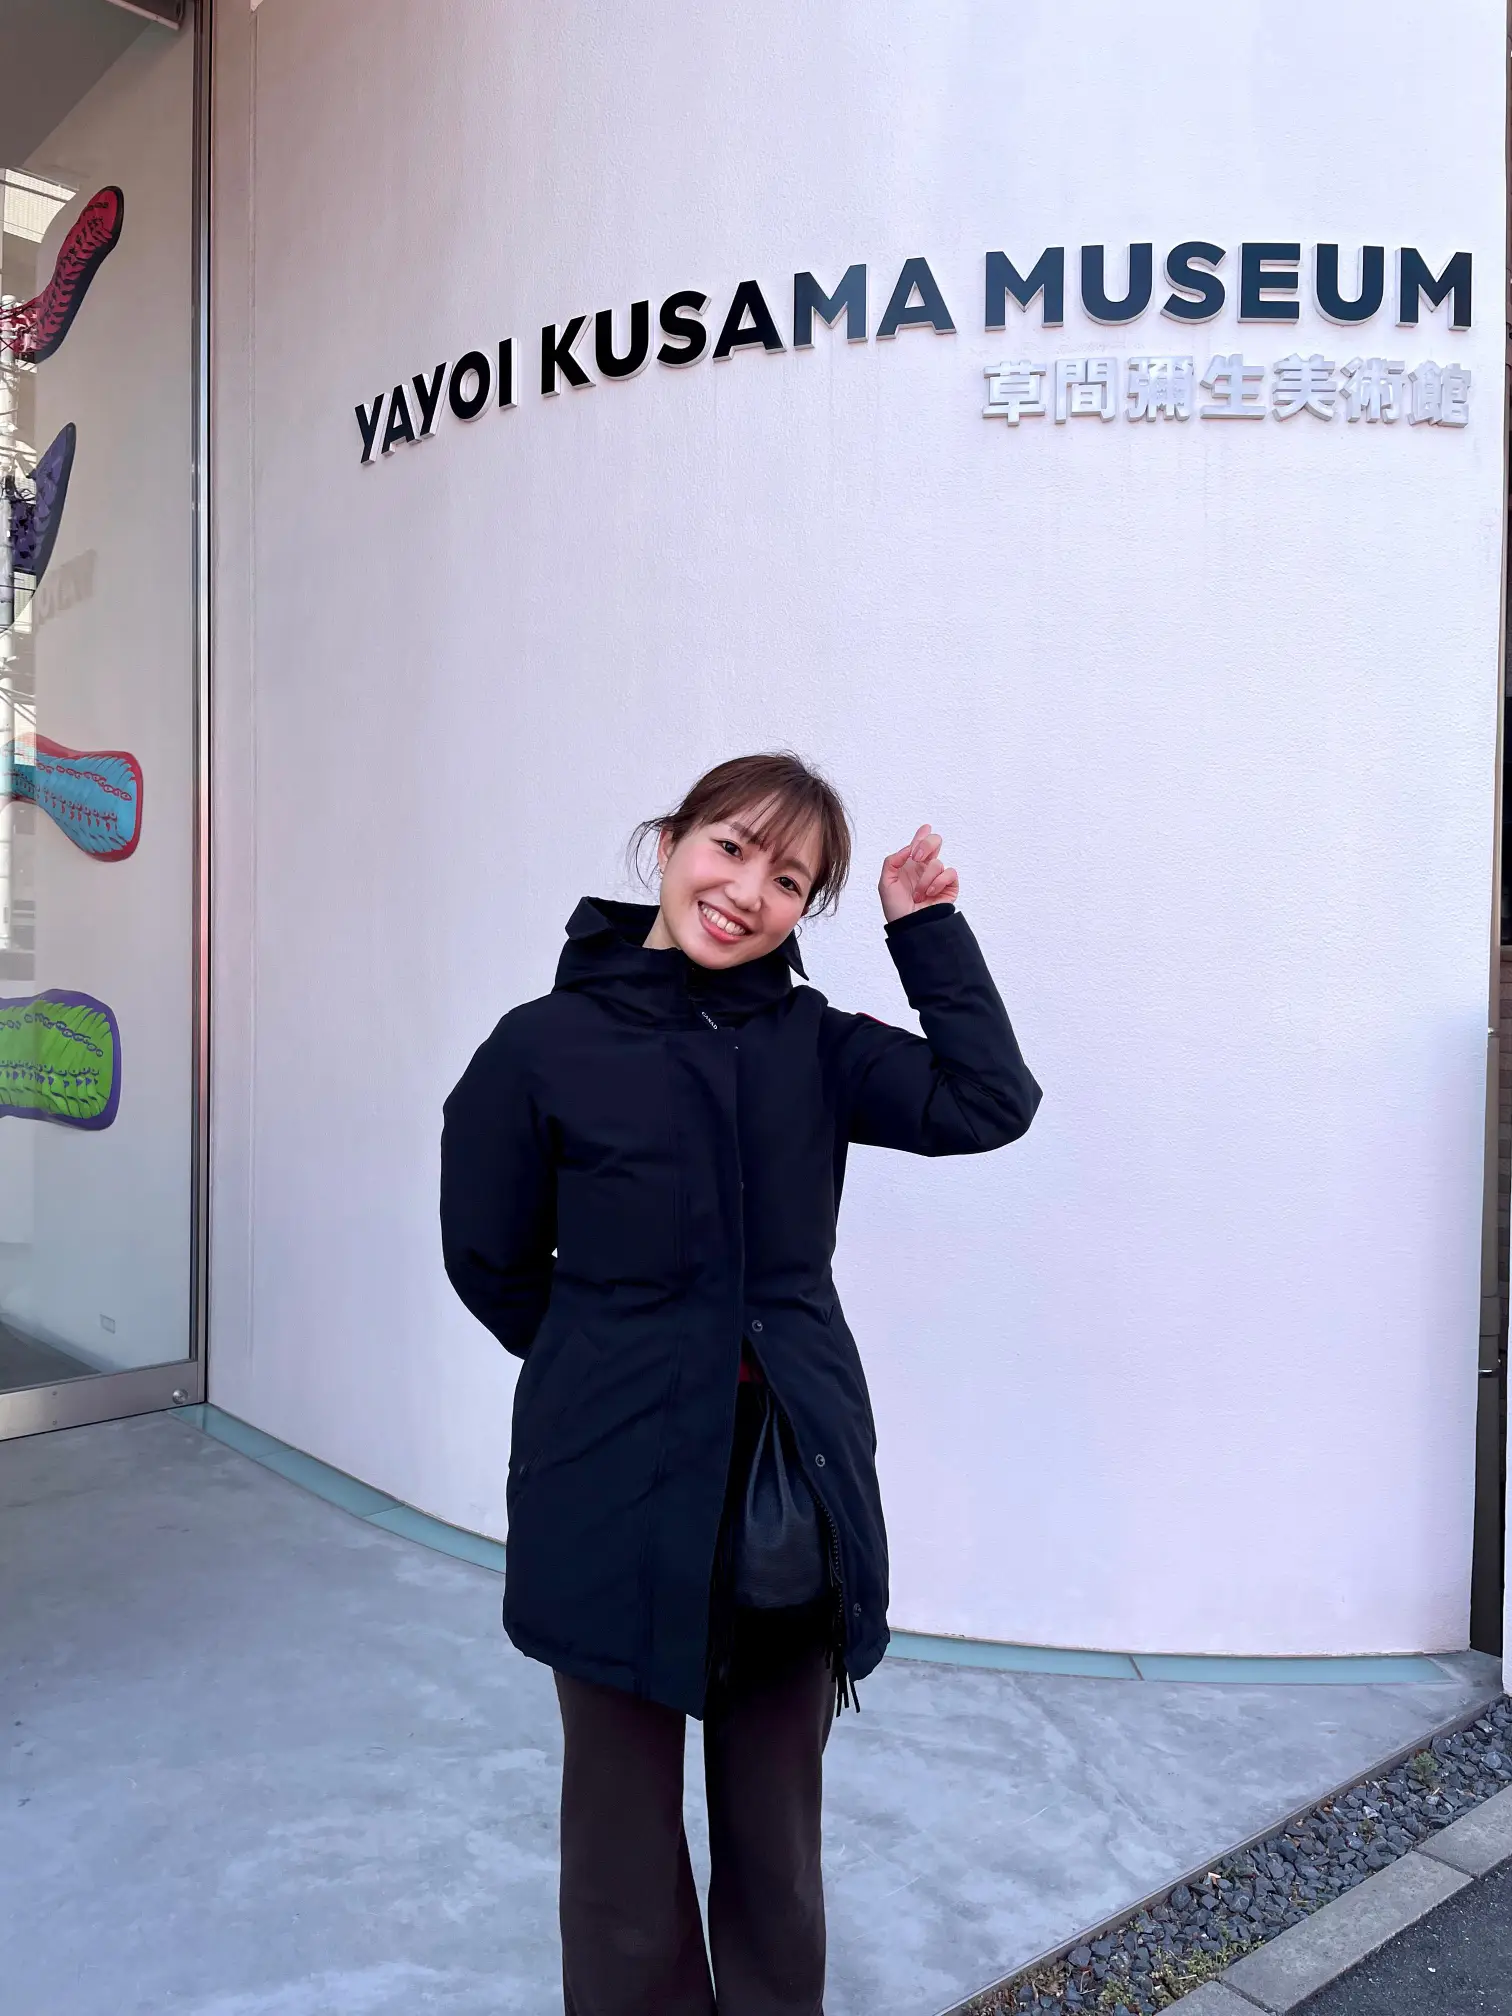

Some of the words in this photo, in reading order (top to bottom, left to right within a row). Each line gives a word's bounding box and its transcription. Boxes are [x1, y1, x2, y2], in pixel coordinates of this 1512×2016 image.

[354, 337, 517, 464] YAYOI
[541, 257, 957, 397] KUSAMA
[984, 241, 1473, 332] MUSEUM
[982, 353, 1472, 428] 草間彌生美術館
